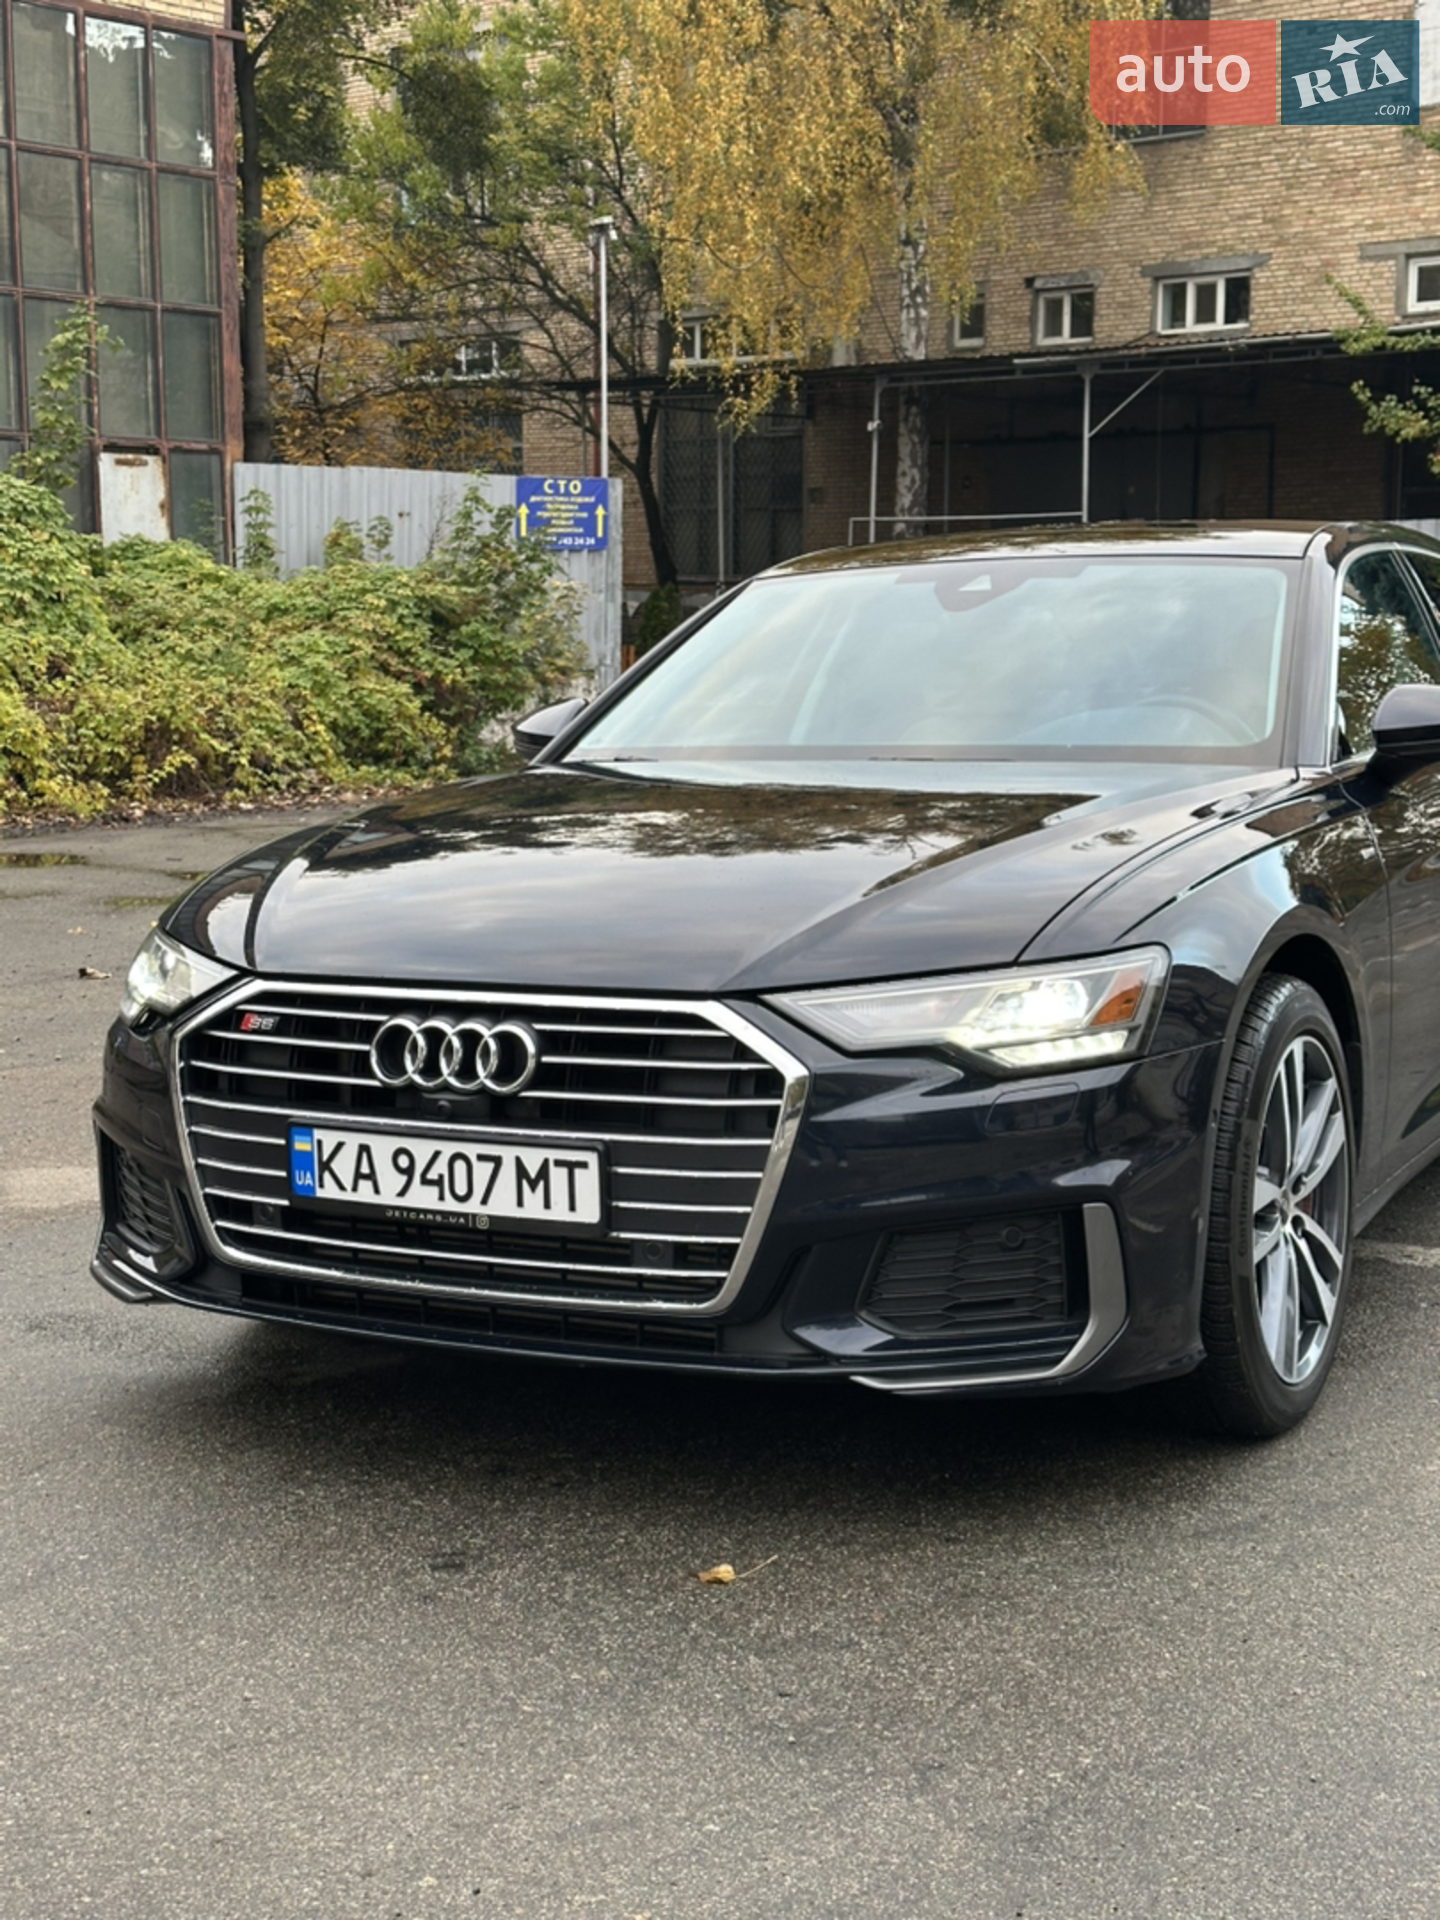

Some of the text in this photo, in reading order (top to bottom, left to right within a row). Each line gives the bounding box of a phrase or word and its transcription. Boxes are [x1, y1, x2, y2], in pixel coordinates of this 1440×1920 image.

[543, 479, 582, 494] СТО
[295, 1169, 314, 1187] UA
[316, 1138, 590, 1212] KA 9407 MT
